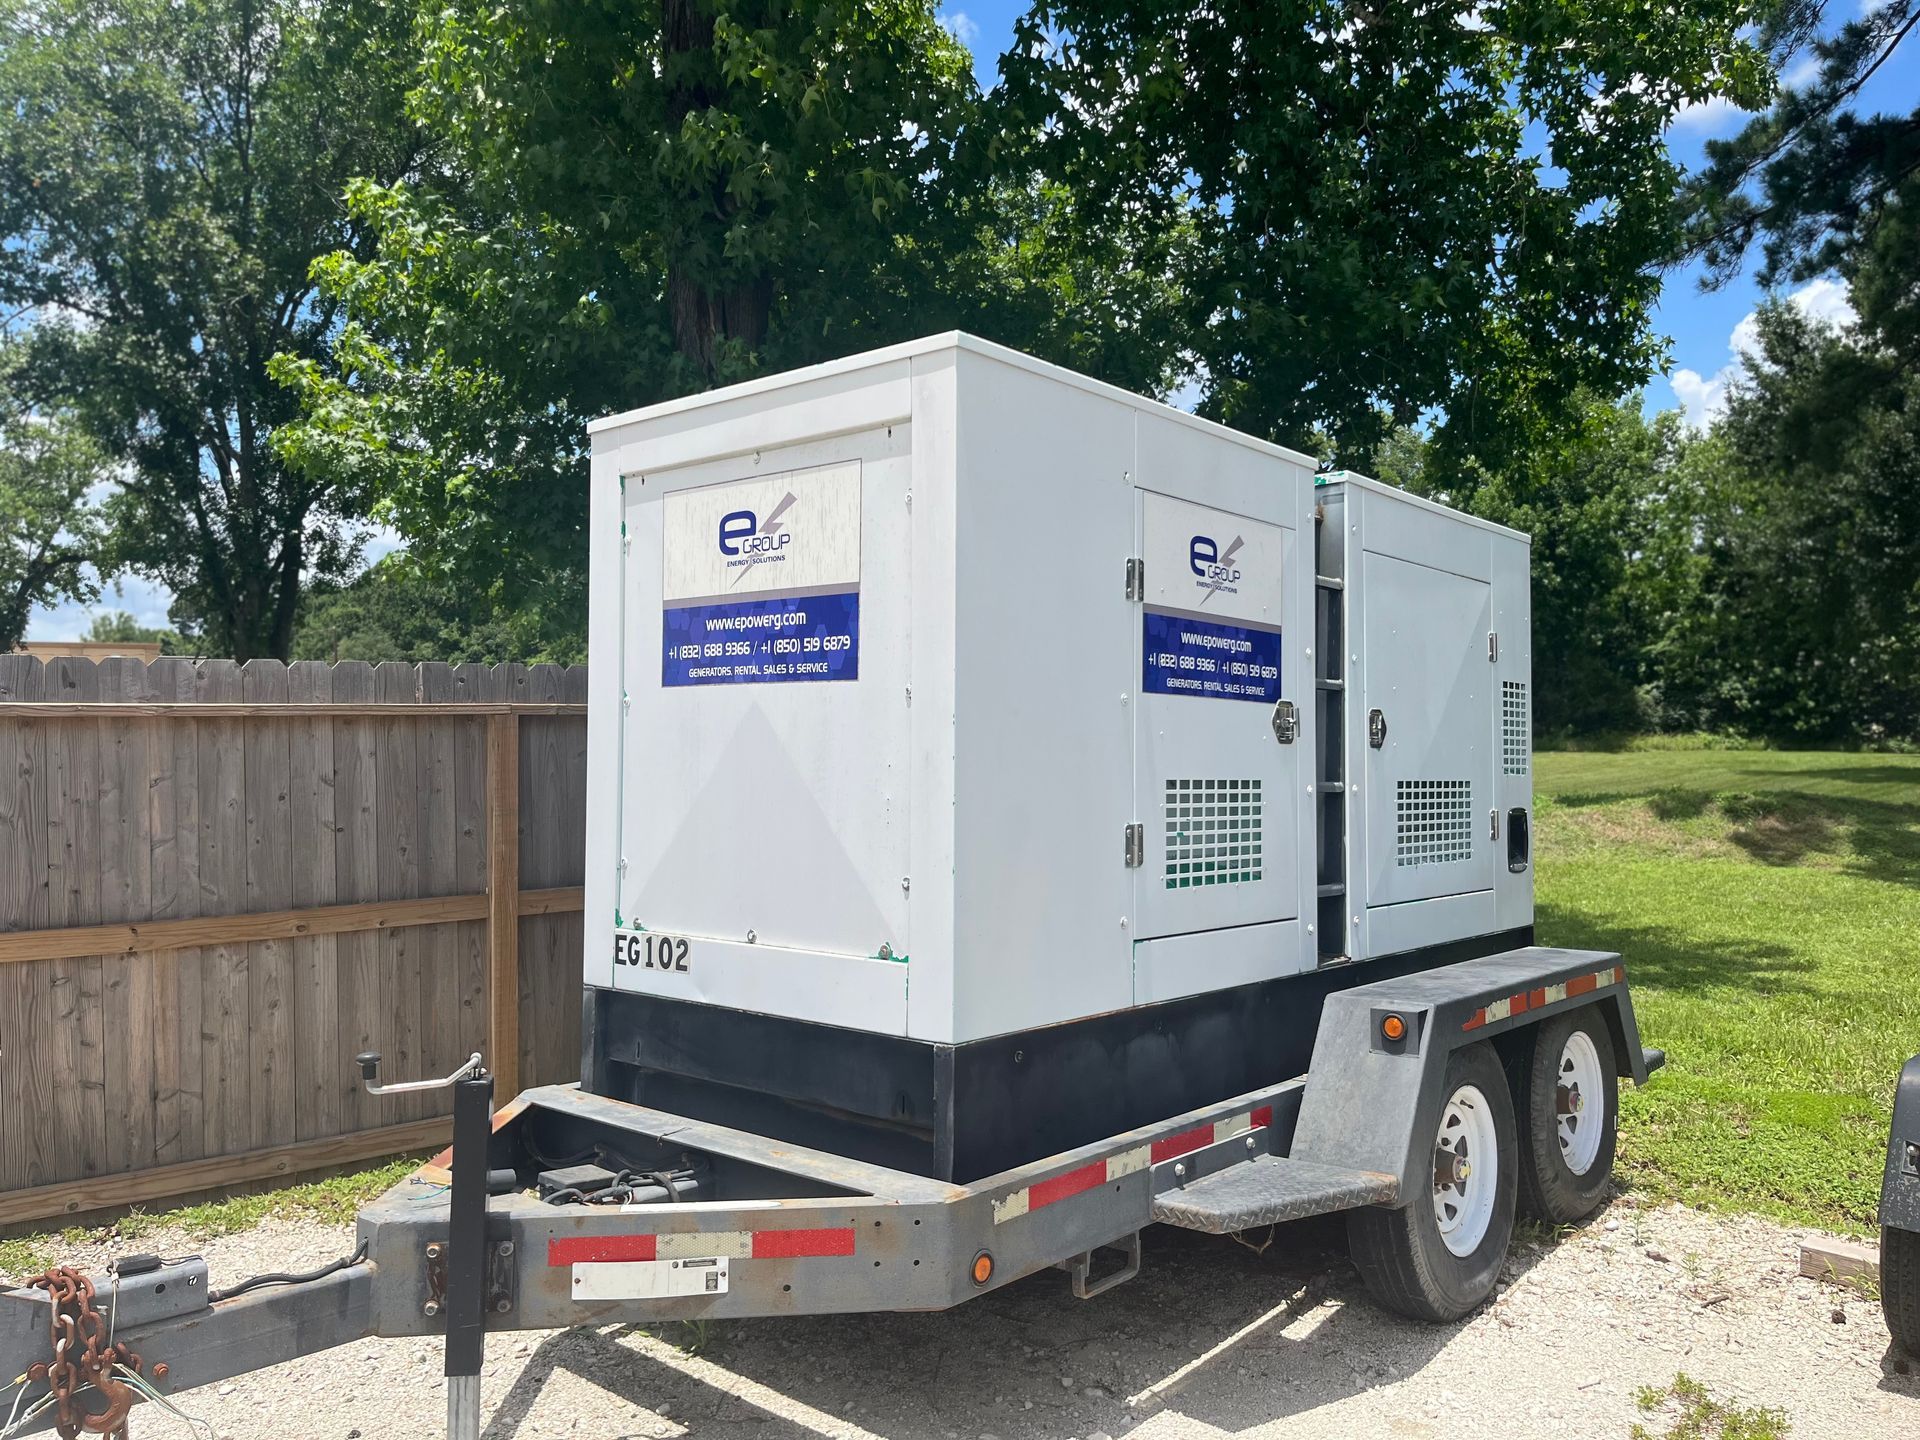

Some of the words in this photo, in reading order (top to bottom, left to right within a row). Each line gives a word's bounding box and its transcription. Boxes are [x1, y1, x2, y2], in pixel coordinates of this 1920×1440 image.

[742, 533, 791, 554] GROUP
[727, 559, 750, 568] ENERGY
[752, 554, 786, 565] SOLUTIONS
[705, 611, 806, 633] www.epowerg.com
[668, 646, 677, 659] +1
[680, 644, 702, 660] (832)
[704, 643, 723, 657] 688
[725, 641, 750, 656] 9366
[760, 639, 770, 654] +1
[773, 638, 801, 655] (850)
[803, 637, 820, 652] 519
[823, 635, 851, 651] 6879
[1180, 631, 1252, 653] www.epowerg.com
[763, 664, 787, 675] SALES
[788, 663, 795, 674] &
[796, 662, 828, 674] SERVICE
[1158, 652, 1178, 669] (832)
[1179, 655, 1195, 669] 688
[1196, 657, 1216, 672] 9366
[1230, 662, 1249, 678] (850)
[1261, 666, 1278, 679] 6879
[614, 934, 689, 972] EG102
